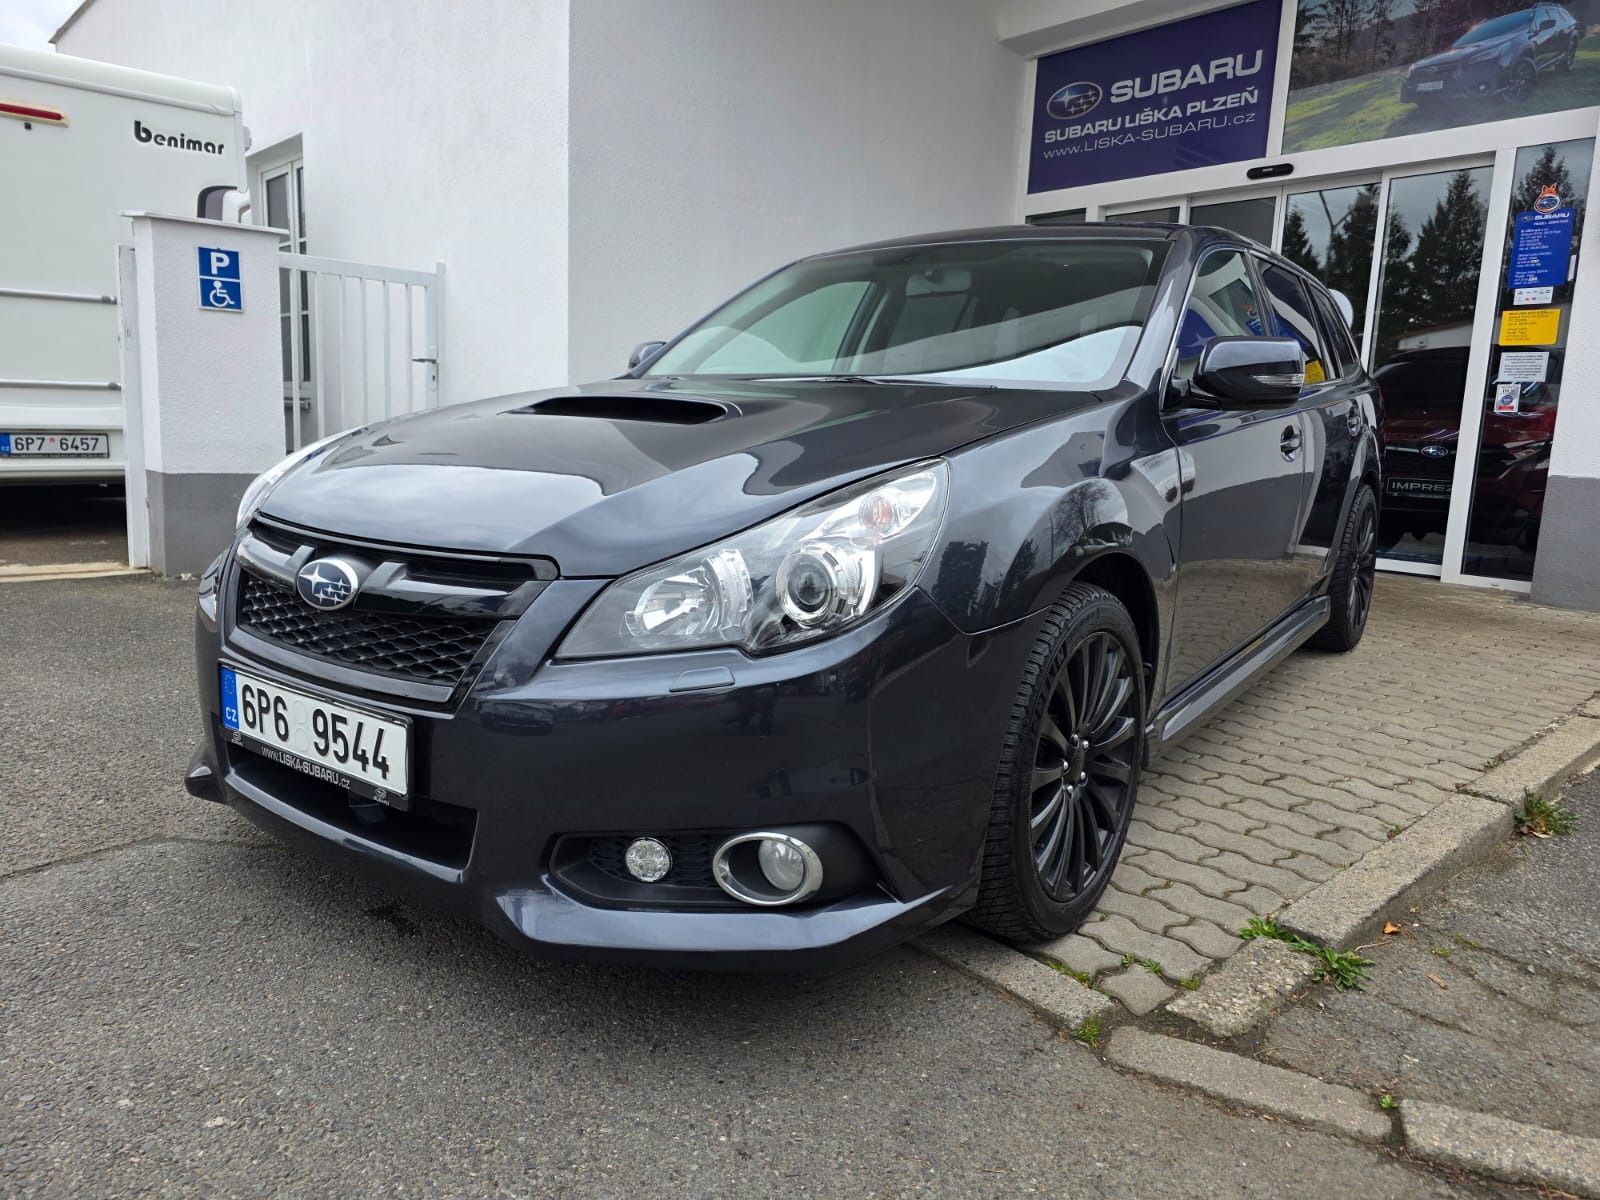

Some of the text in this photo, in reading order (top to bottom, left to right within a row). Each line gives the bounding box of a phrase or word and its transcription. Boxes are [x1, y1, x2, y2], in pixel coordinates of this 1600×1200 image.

[1110, 49, 1263, 104] SUBARU
[1043, 112, 1256, 160] www.LISKA-SUBARU.cz
[1044, 86, 1259, 144] SUBARU LIŠKA PLZEŇ
[133, 120, 225, 155] benimar
[210, 251, 230, 275] P
[14, 436, 99, 451] 6P7 6457
[225, 707, 238, 722] CZ
[241, 684, 390, 781] 6P6 9544
[261, 746, 350, 790] www.LISKA-SUBARU.cz
